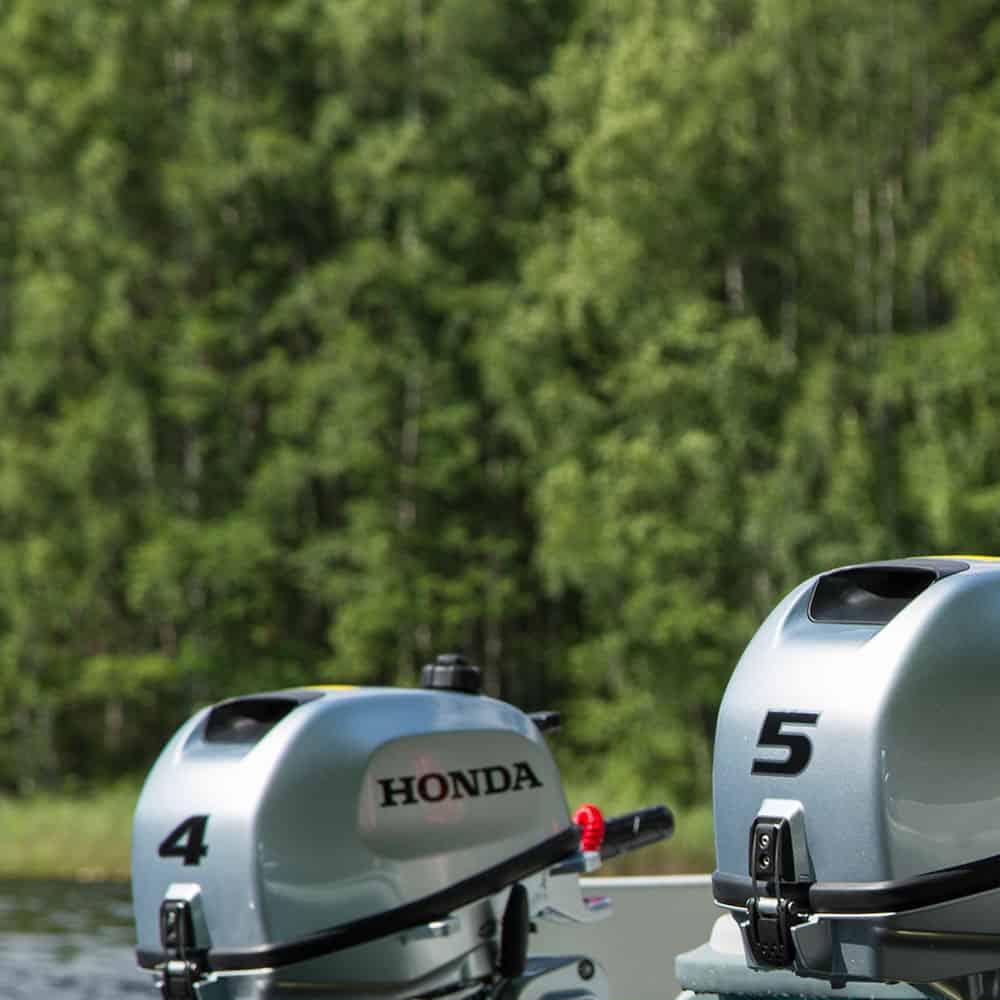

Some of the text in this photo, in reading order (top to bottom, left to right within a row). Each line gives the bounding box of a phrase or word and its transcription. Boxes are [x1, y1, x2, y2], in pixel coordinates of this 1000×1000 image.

[751, 711, 820, 777] 5
[377, 761, 543, 808] HONDA
[158, 815, 209, 867] 4
